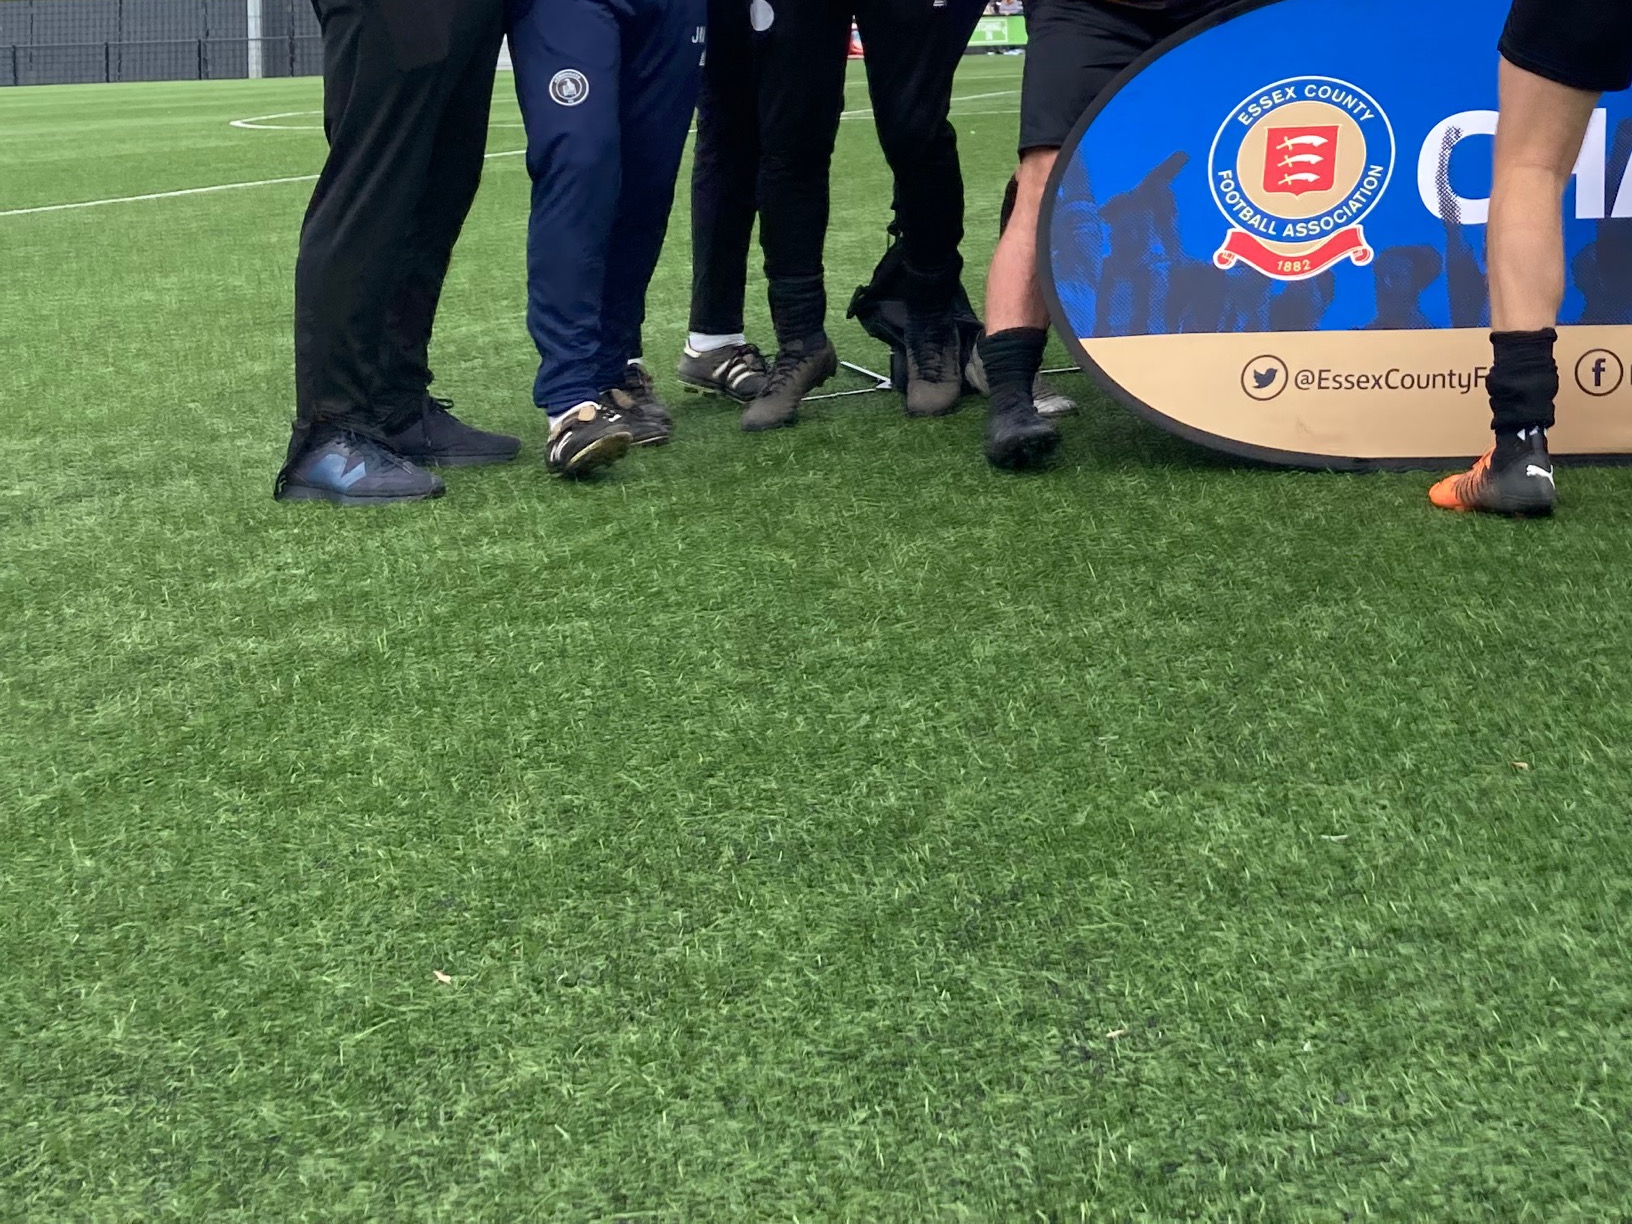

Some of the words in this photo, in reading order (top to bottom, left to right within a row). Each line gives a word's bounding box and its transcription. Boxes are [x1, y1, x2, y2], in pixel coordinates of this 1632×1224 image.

[1237, 86, 1298, 126] ESSEX
[1303, 84, 1375, 122] COUNTY
[1218, 169, 1277, 235] FOOTBALL
[1282, 164, 1384, 238] ASSOCIATION
[1277, 259, 1311, 273] 1882
[1294, 366, 1489, 394] @EssexCountyF
